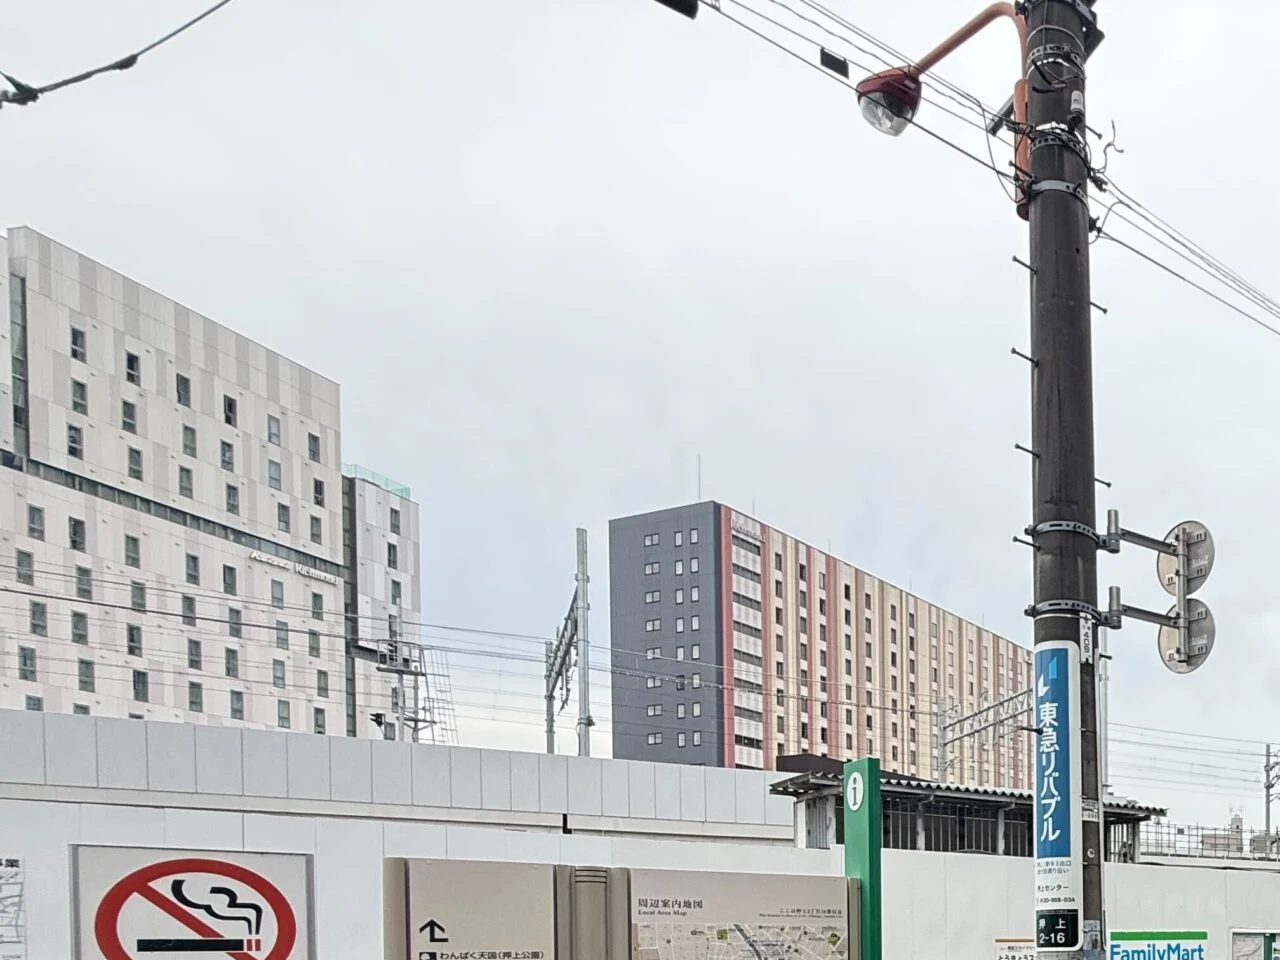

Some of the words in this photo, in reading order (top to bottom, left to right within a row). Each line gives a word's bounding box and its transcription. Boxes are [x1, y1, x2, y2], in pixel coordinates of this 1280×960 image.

[1039, 701, 1061, 842] 東急リバブル
[1039, 932, 1066, 944] 2-16
